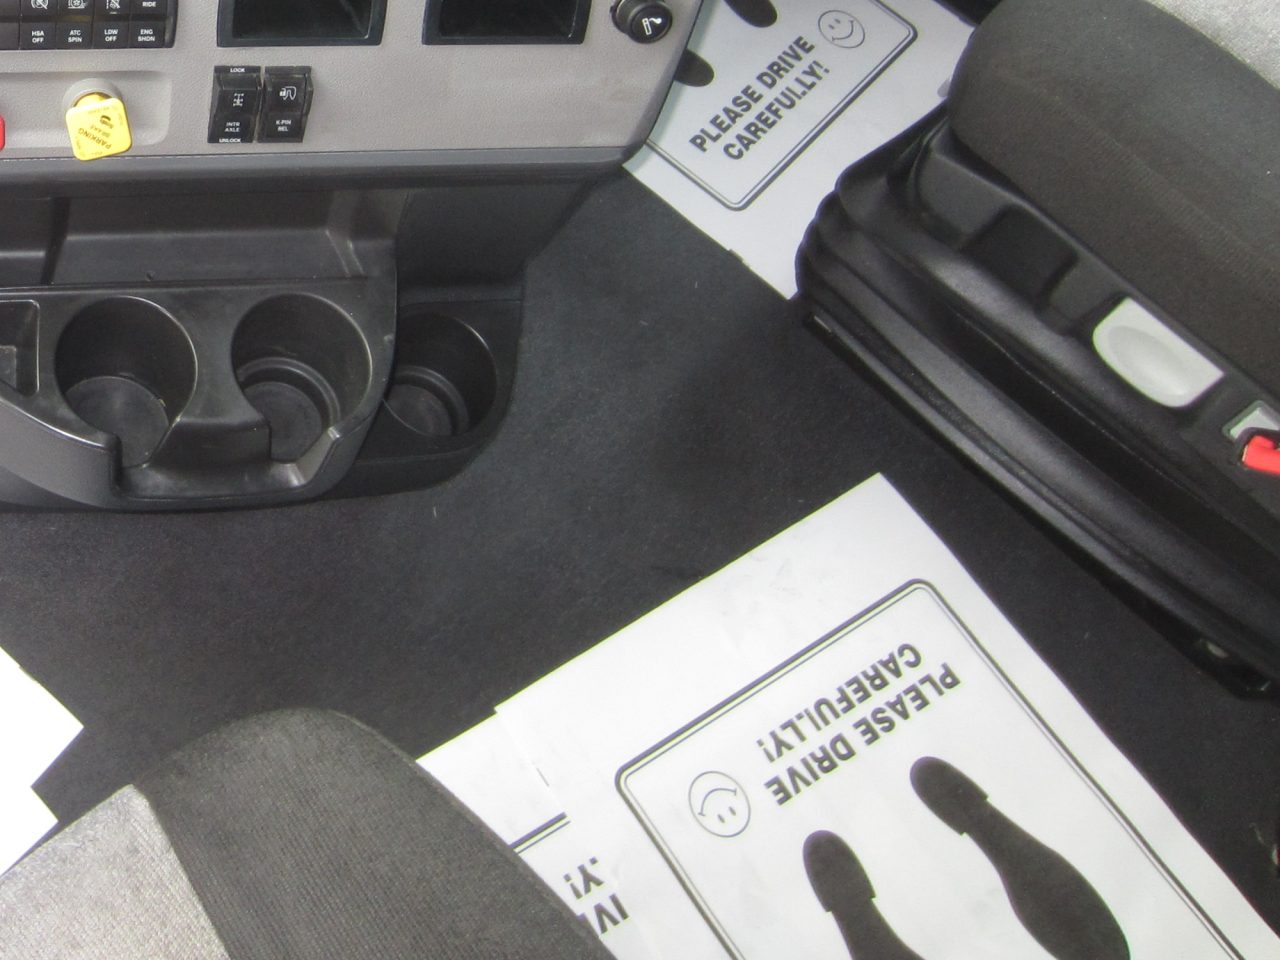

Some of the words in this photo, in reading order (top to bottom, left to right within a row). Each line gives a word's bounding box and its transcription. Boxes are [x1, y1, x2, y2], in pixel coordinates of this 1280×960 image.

[688, 85, 764, 153] PLEASE
[756, 35, 816, 90] DRIVE
[723, 60, 831, 160] CAREFULLY!
[756, 643, 923, 764] CAREFULLY!
[852, 662, 961, 746] PLEASE
[763, 732, 857, 807] DRIVE
